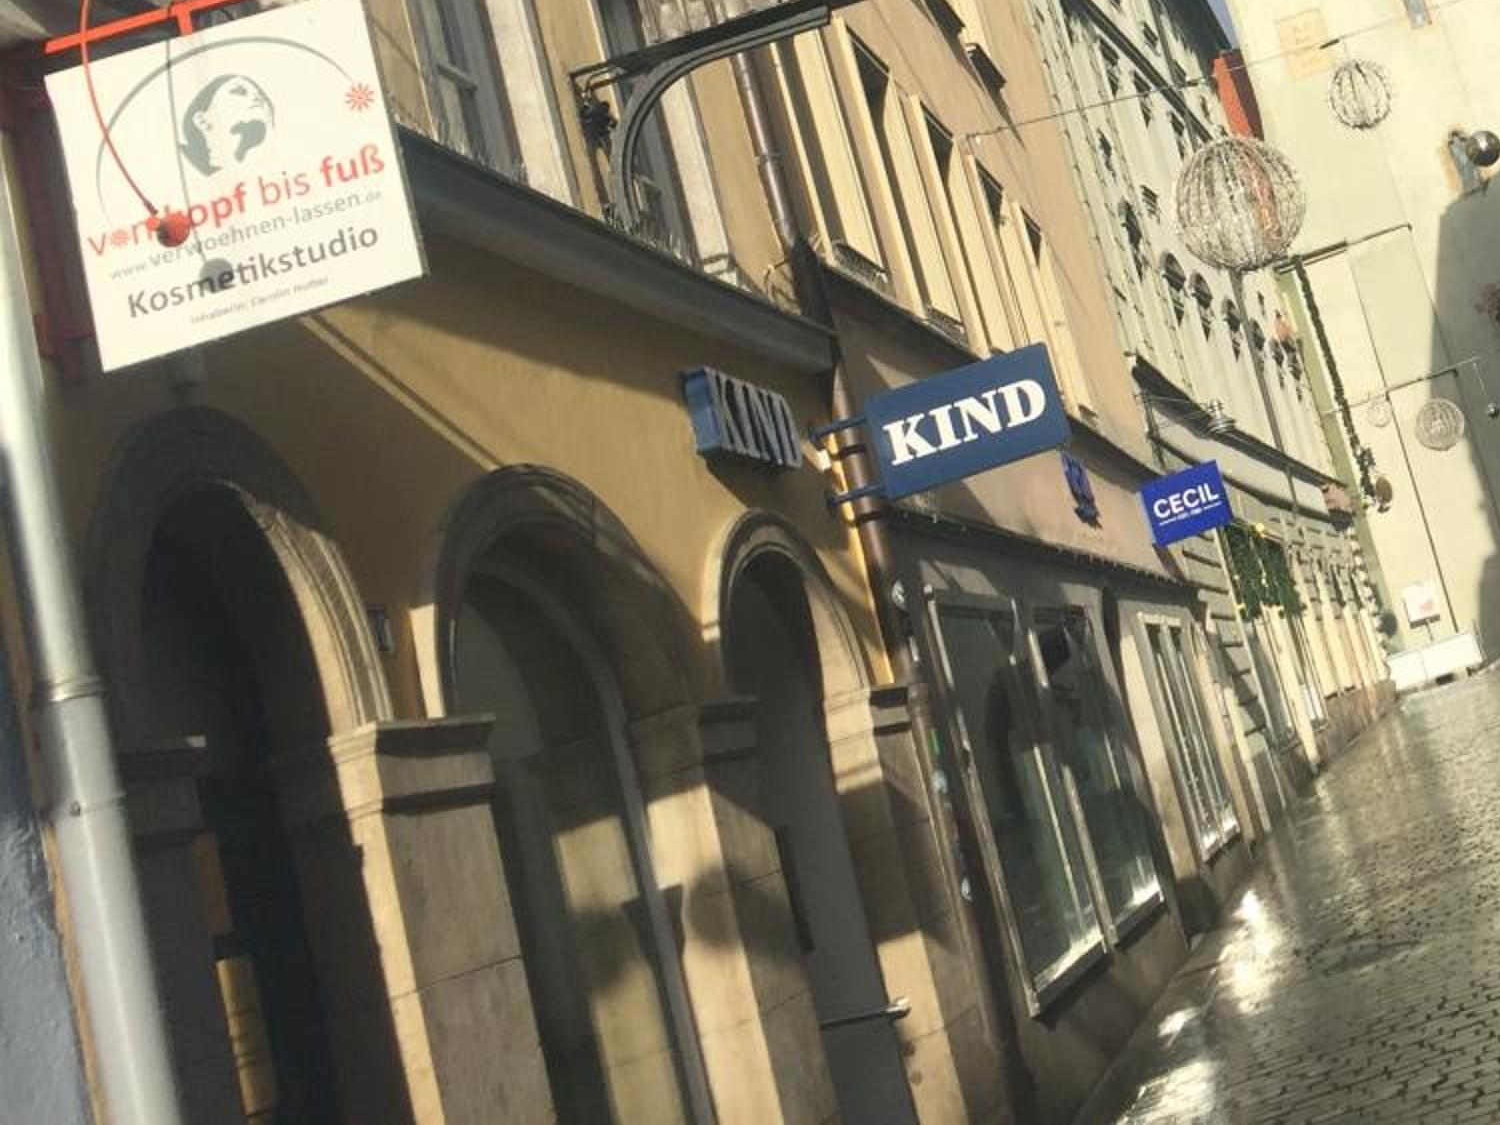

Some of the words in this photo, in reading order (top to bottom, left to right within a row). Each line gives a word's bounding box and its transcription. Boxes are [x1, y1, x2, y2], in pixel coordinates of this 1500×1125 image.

[163, 181, 247, 233] opf
[258, 171, 311, 207] bis
[320, 143, 386, 188] fuß
[127, 225, 379, 318] Kosmetikstudio
[703, 366, 803, 468] KIND
[882, 378, 1047, 466] KIND
[1152, 482, 1220, 518] CECIL
